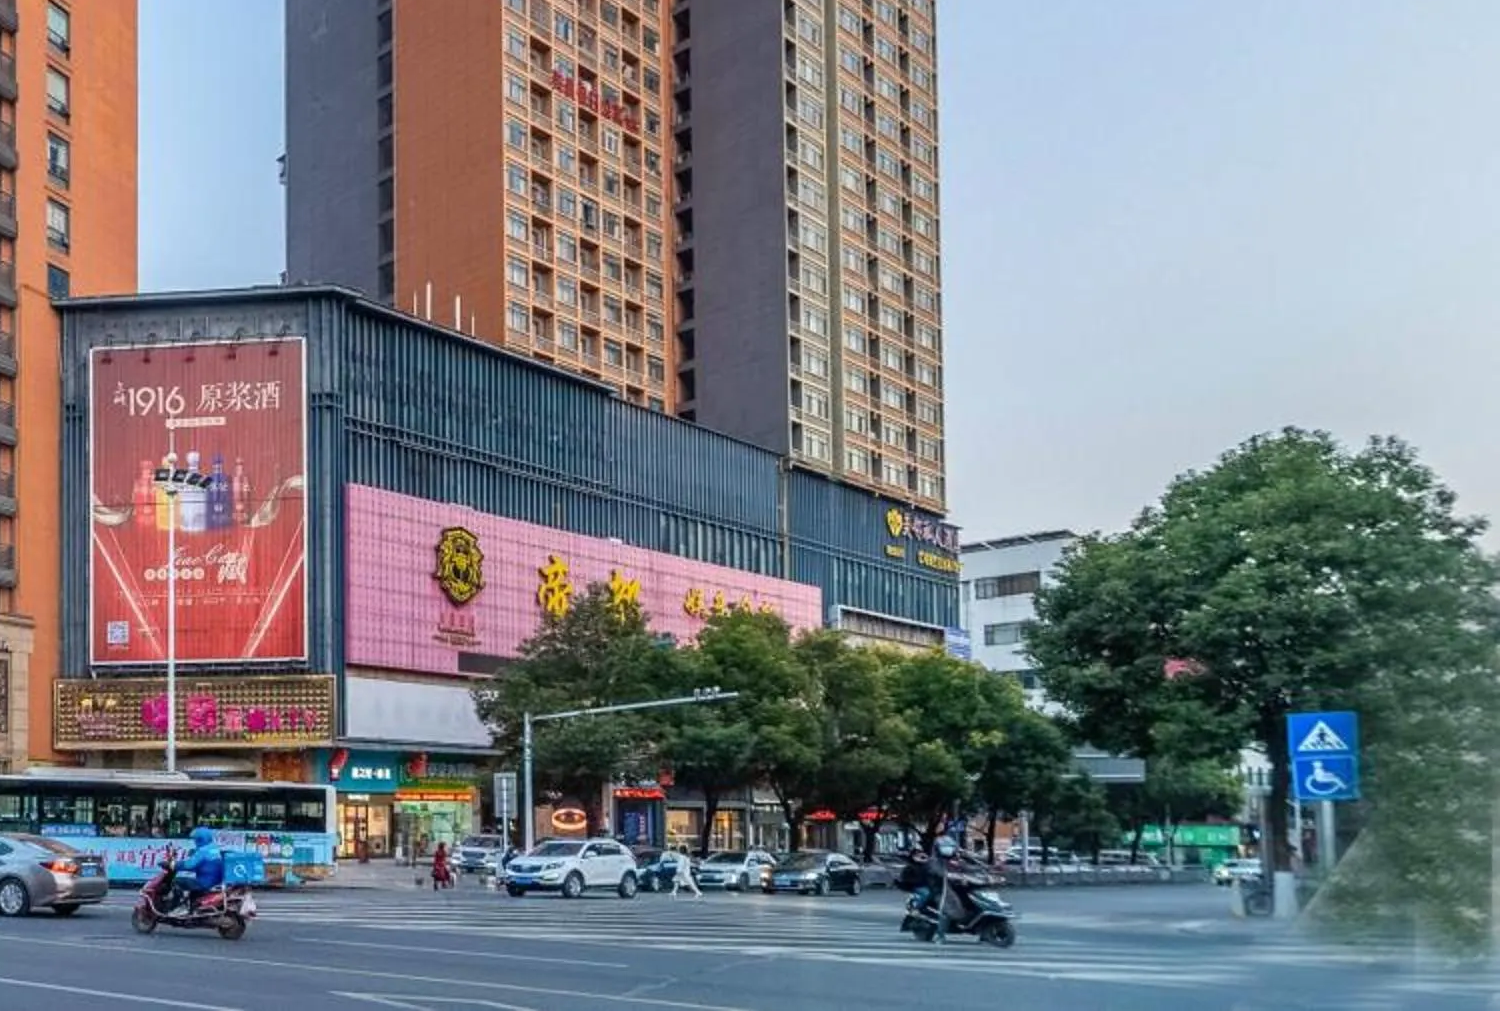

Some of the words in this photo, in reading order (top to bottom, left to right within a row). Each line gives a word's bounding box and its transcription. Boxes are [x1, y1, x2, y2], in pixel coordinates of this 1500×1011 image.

[127, 385, 186, 416] 1916
[196, 380, 282, 413] 原浆酒
